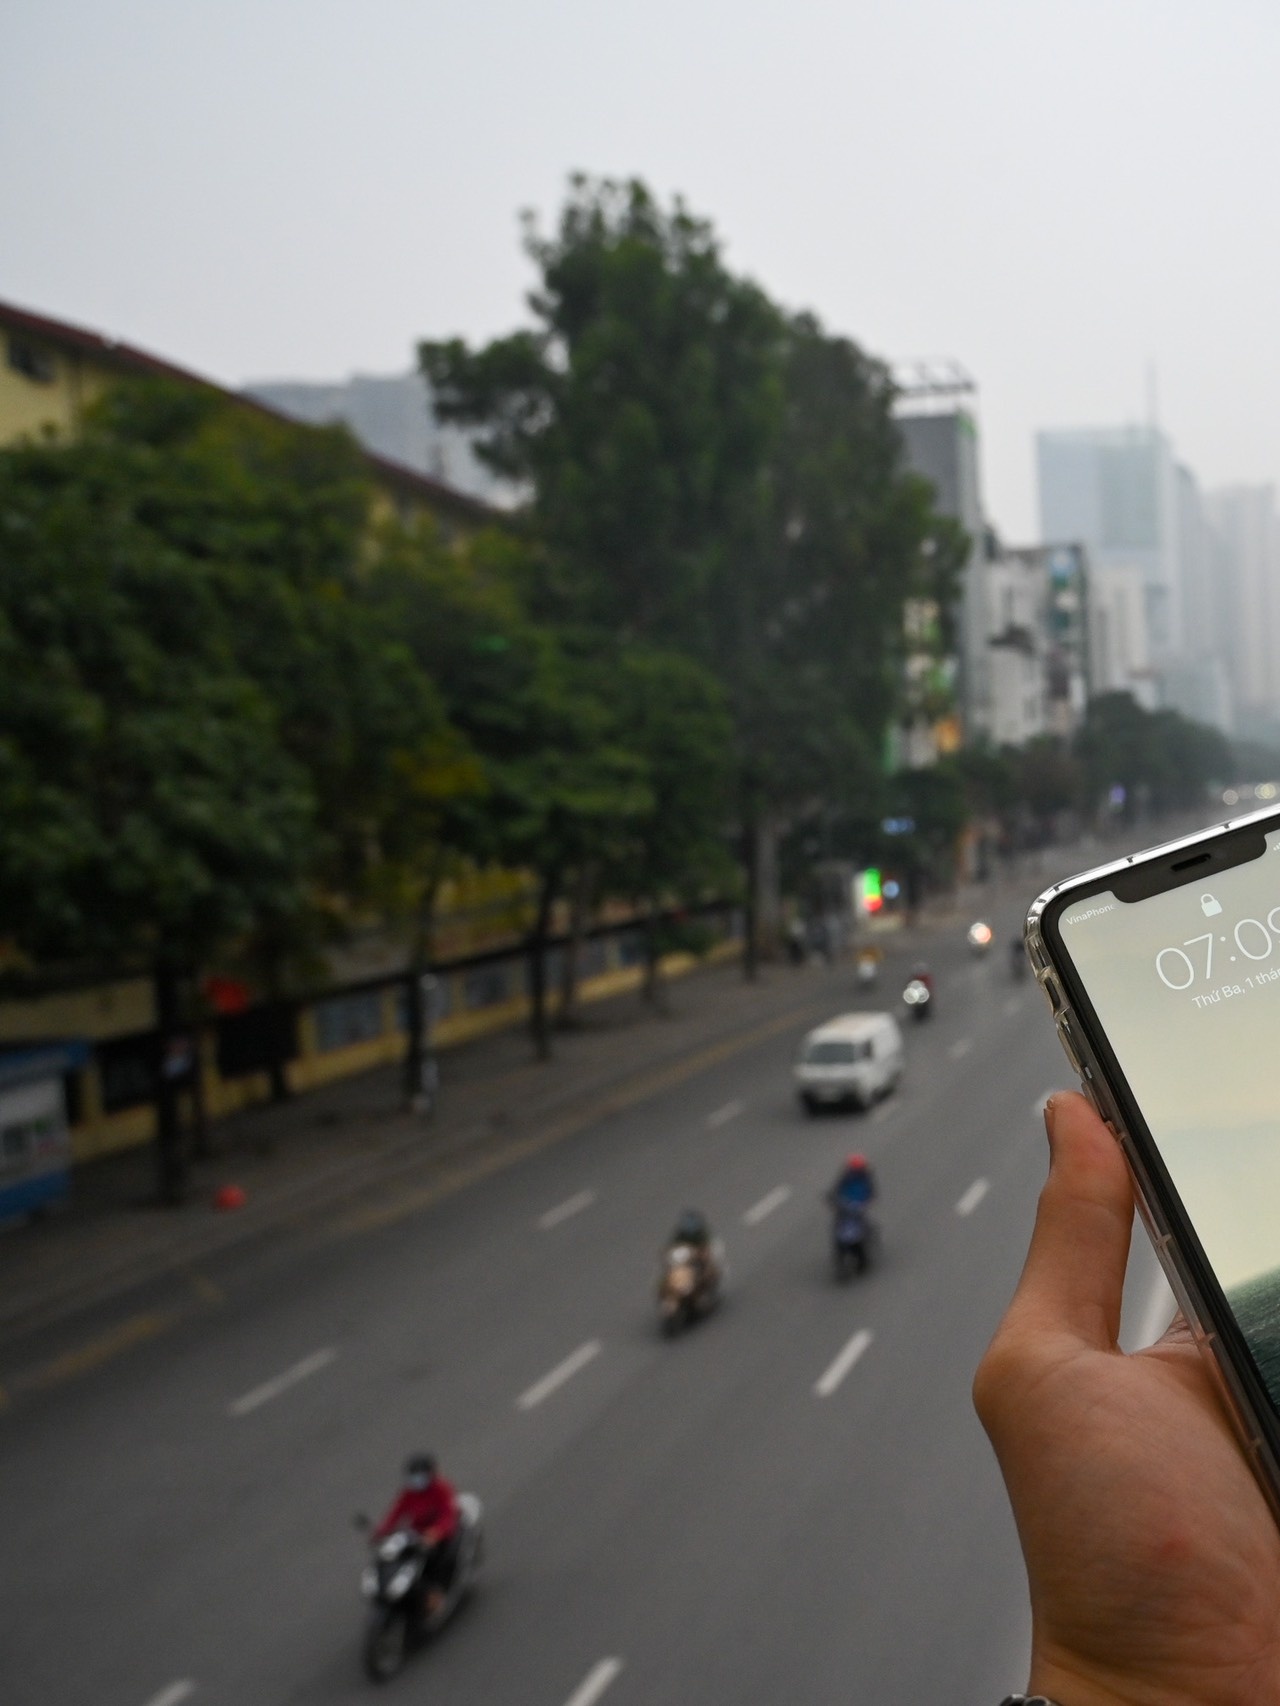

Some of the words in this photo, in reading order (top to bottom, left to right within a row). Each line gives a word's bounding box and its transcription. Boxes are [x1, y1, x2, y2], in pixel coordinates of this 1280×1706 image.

[1191, 989, 1221, 1009] Thứ
[1221, 984, 1246, 999] Ba,
[1245, 977, 1254, 989] 1
